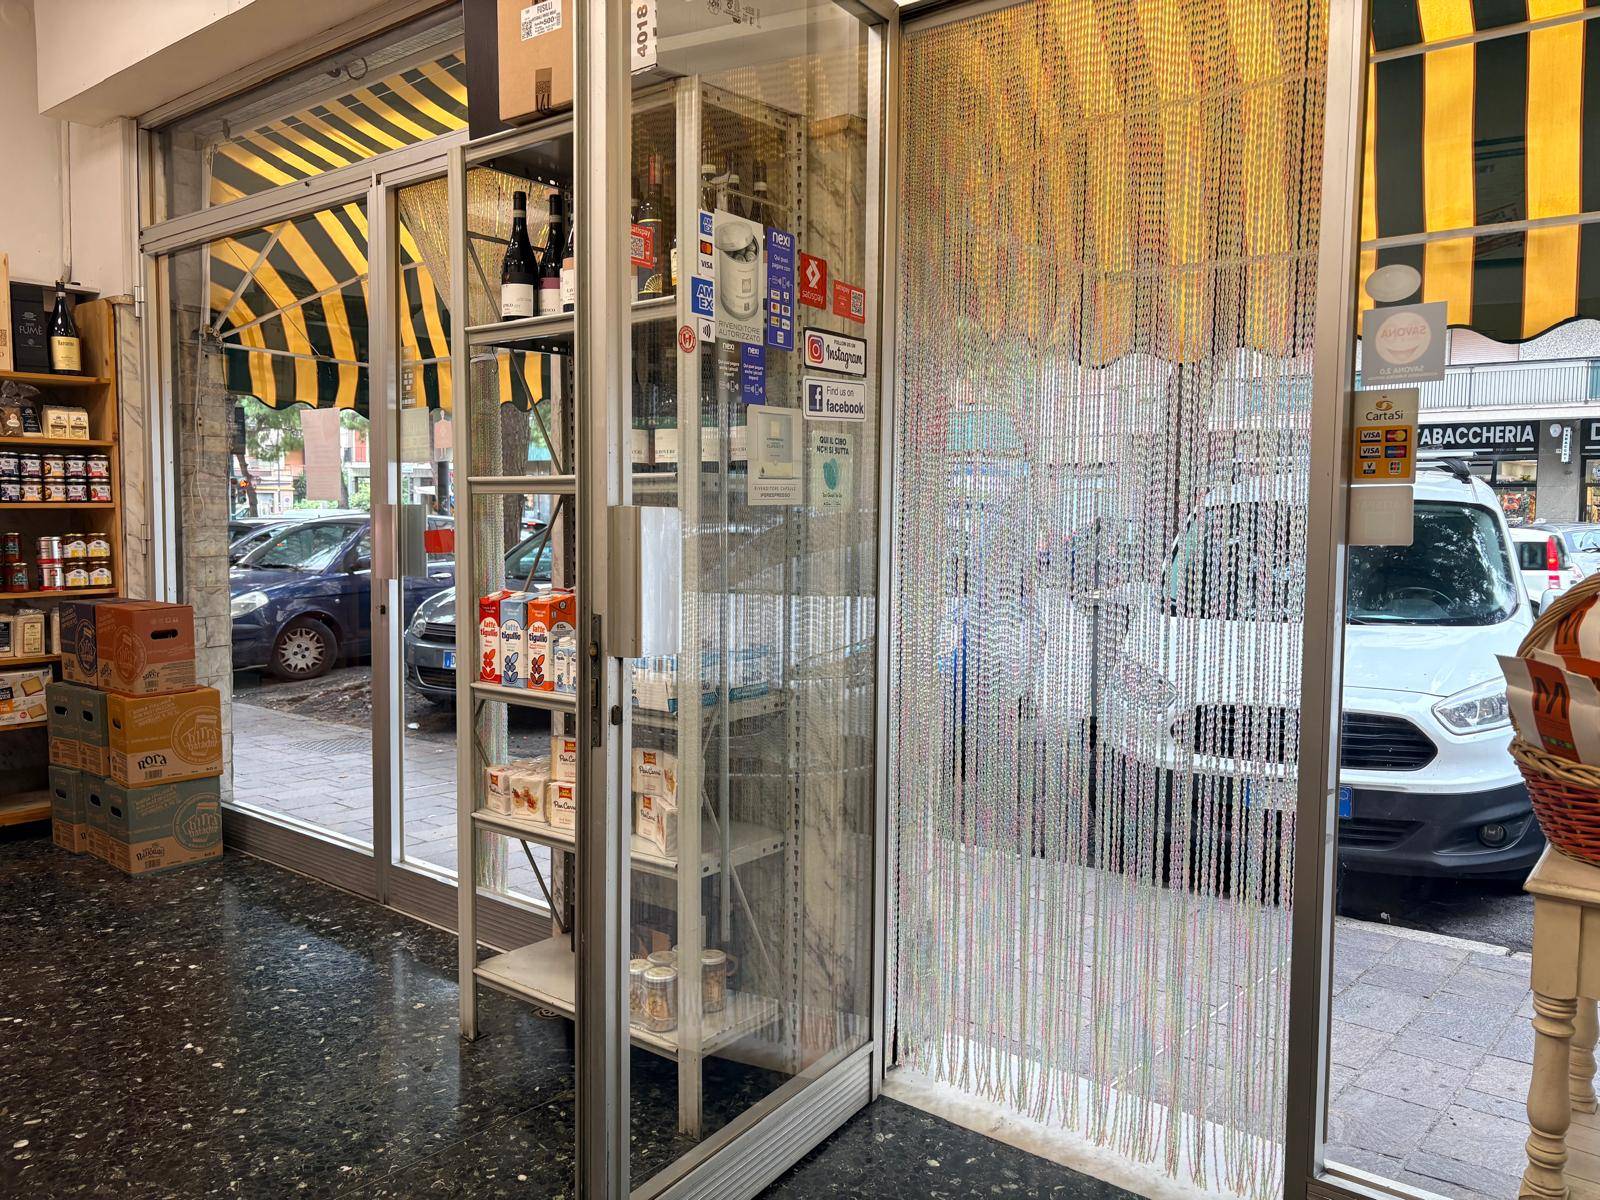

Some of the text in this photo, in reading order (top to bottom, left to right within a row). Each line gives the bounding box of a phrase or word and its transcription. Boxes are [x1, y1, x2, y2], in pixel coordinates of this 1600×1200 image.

[637, 5, 647, 57] 4018
[772, 231, 790, 248] nexi
[700, 260, 713, 269] VISA
[697, 284, 713, 299] AM
[801, 290, 824, 305] satispay
[719, 321, 760, 334] RIVENDITORE
[719, 328, 761, 342] AUTORIZZATO
[826, 344, 863, 369] Instagram
[826, 385, 839, 396] Find
[840, 388, 847, 396] us
[826, 399, 864, 414] facebook
[1365, 410, 1404, 421] CartaSi
[1363, 447, 1380, 455] VISA
